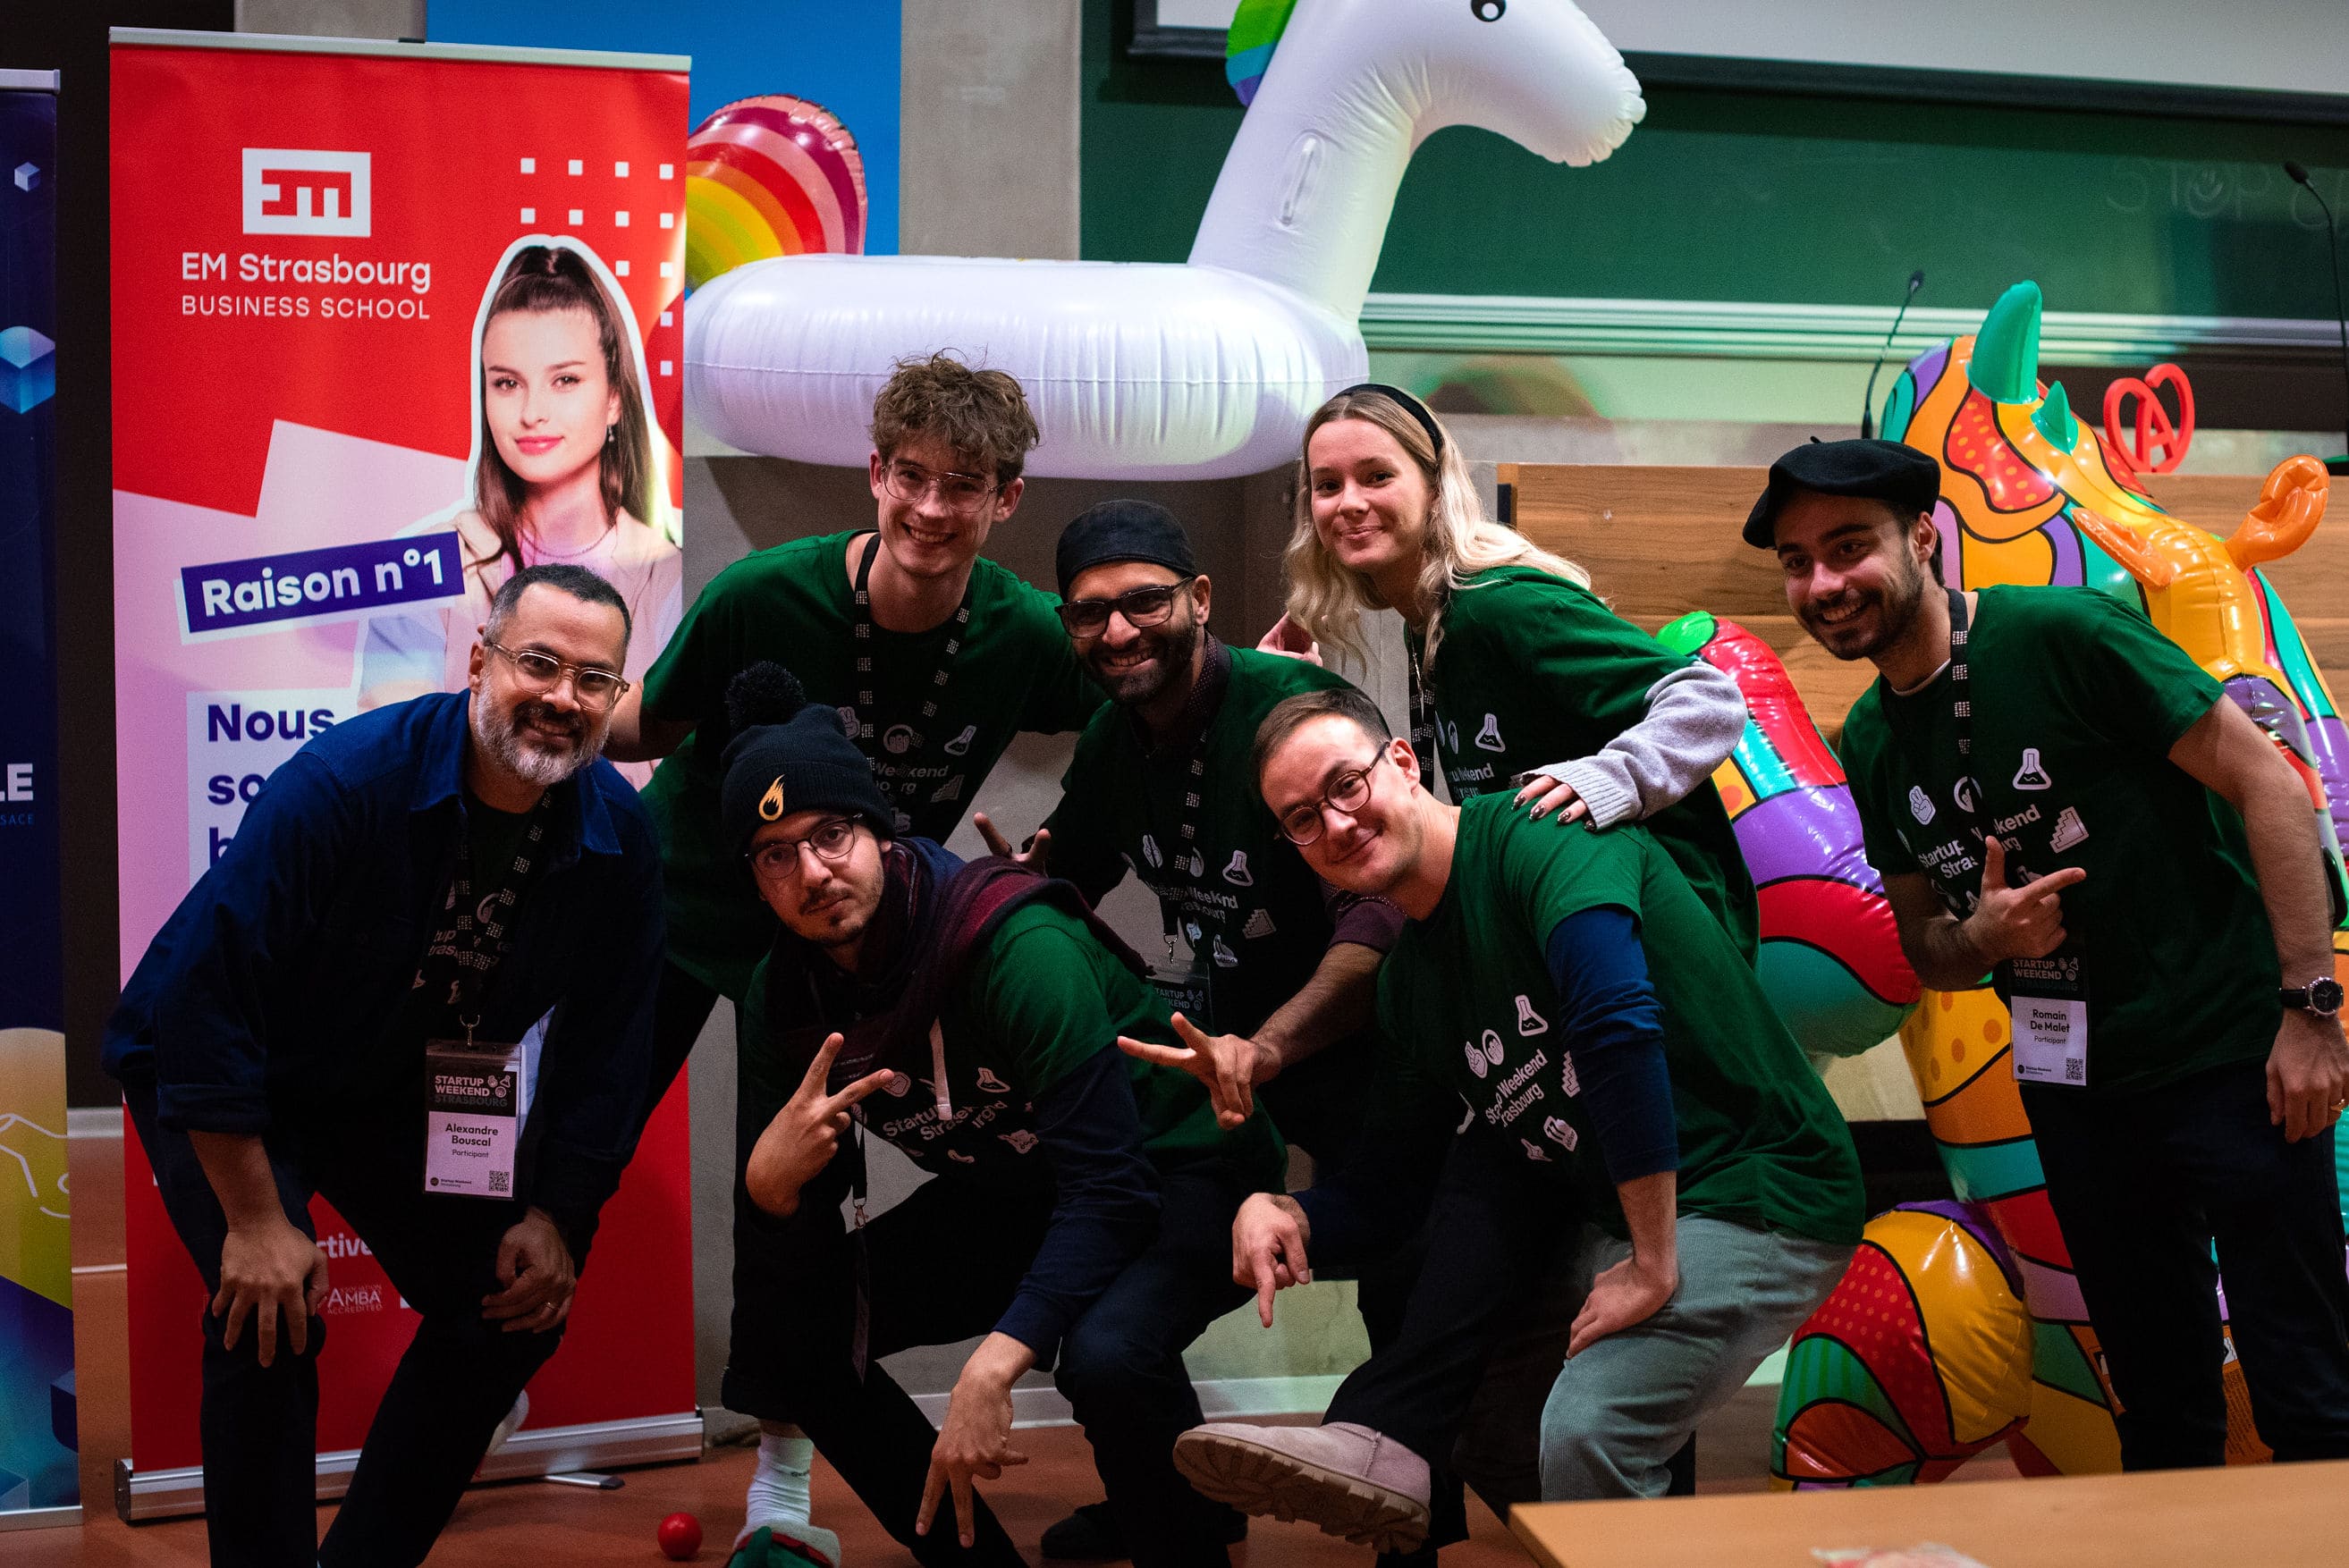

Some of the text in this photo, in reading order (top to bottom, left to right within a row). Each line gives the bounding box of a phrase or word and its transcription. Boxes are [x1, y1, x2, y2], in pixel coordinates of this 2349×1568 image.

[182, 252, 431, 295] EM Strasbourg
[182, 295, 430, 320] BUSINESS SCHOOL
[201, 567, 361, 617] Raison
[207, 704, 335, 742] Nous
[0, 763, 34, 802] E
[207, 773, 267, 805] so
[2012, 958, 2056, 970] STARTUP
[2013, 968, 2062, 981] WEEKEND
[2032, 1008, 2067, 1021] Romain
[2030, 1020, 2070, 1033] De Malet
[2034, 1035, 2066, 1045] Participant
[1496, 1048, 1549, 1099] Weekend
[435, 1075, 485, 1087] STARTUP
[435, 1084, 490, 1097] WEEKEND
[1500, 1082, 1545, 1128] rasbourg
[445, 1123, 499, 1136] Alexandre
[452, 1134, 491, 1147] Bouscal
[452, 1149, 489, 1159] Participant
[327, 1287, 381, 1309] AMBA
